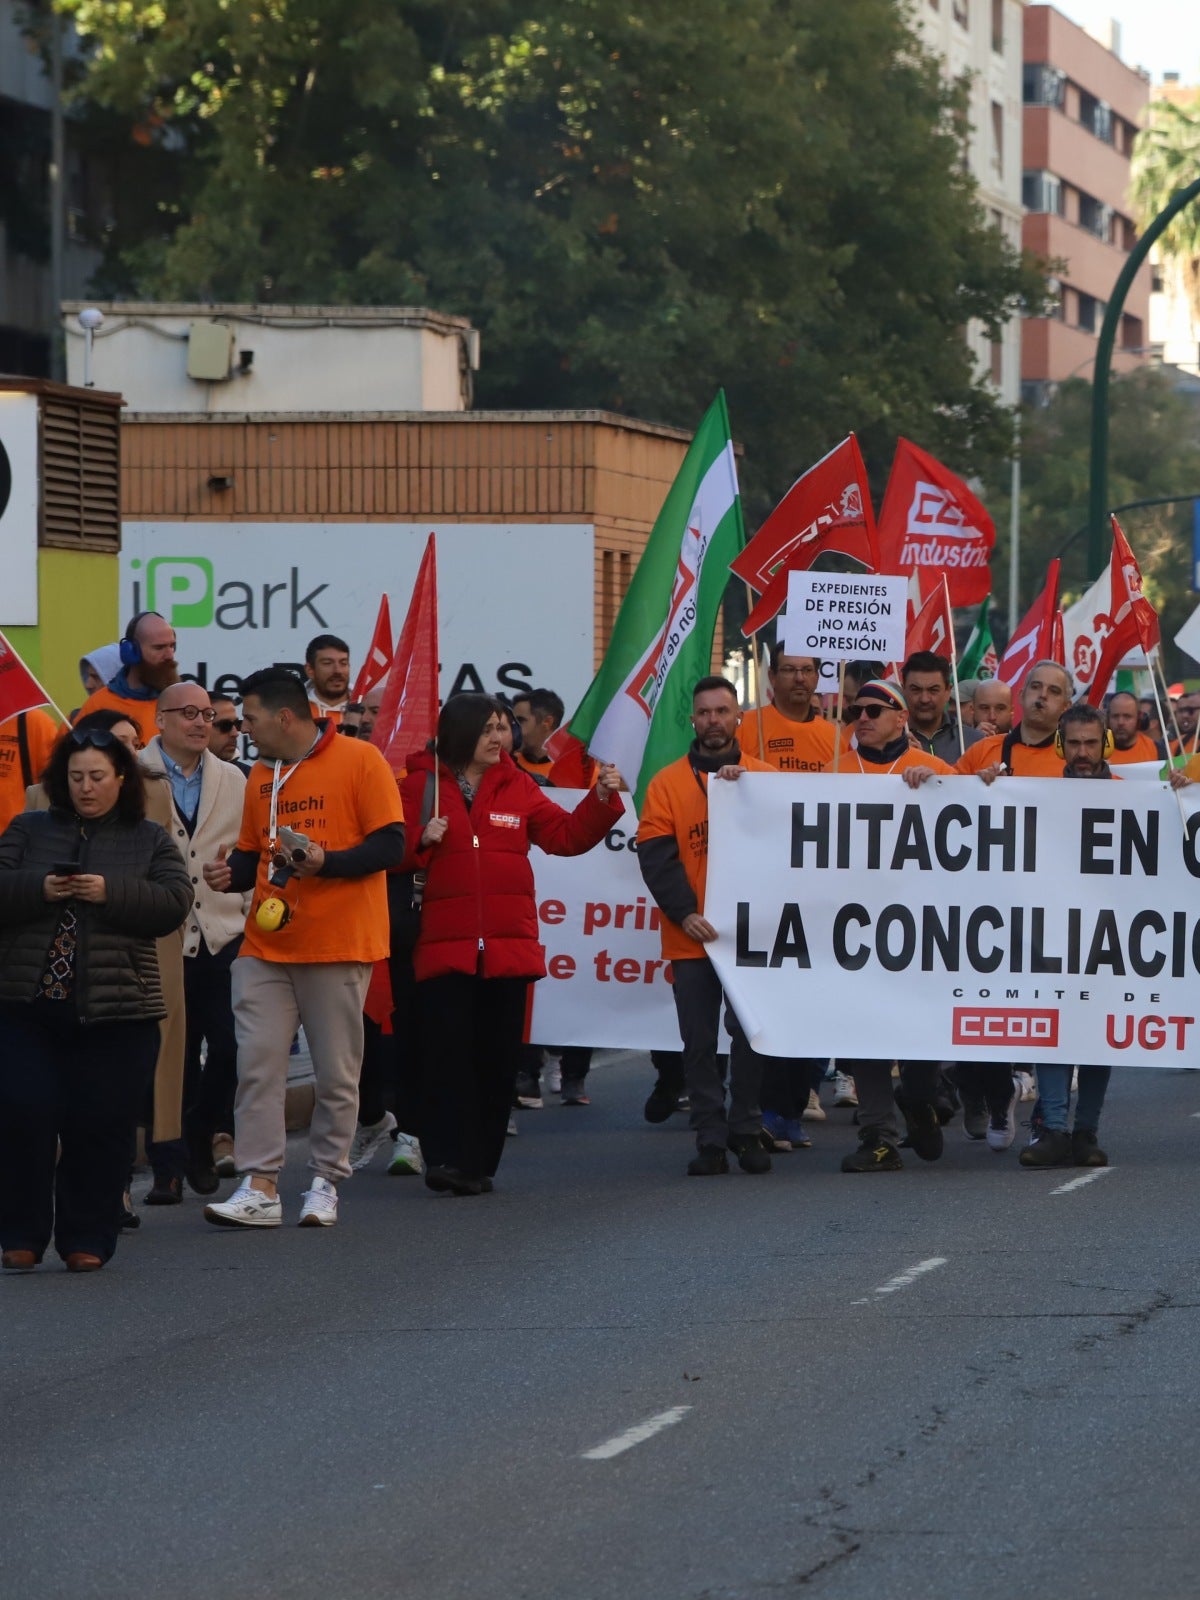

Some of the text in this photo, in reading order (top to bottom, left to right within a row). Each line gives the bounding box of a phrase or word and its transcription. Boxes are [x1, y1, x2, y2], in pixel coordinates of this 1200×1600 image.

[131, 557, 329, 630] iPark
[811, 582, 887, 596] EXPEDIENTES
[805, 599, 891, 615] DE PRESIÓN
[818, 617, 877, 632] ¡NO MÁS
[806, 633, 887, 651] OPRESIÓN!
[790, 802, 1038, 872] HITACHI
[1080, 808, 1159, 876] EN
[735, 902, 812, 969] LA
[952, 988, 1091, 1001] COMITE
[1124, 992, 1160, 1003] DE
[960, 1015, 1051, 1039] CCOO
[1106, 1014, 1195, 1051] UGT
